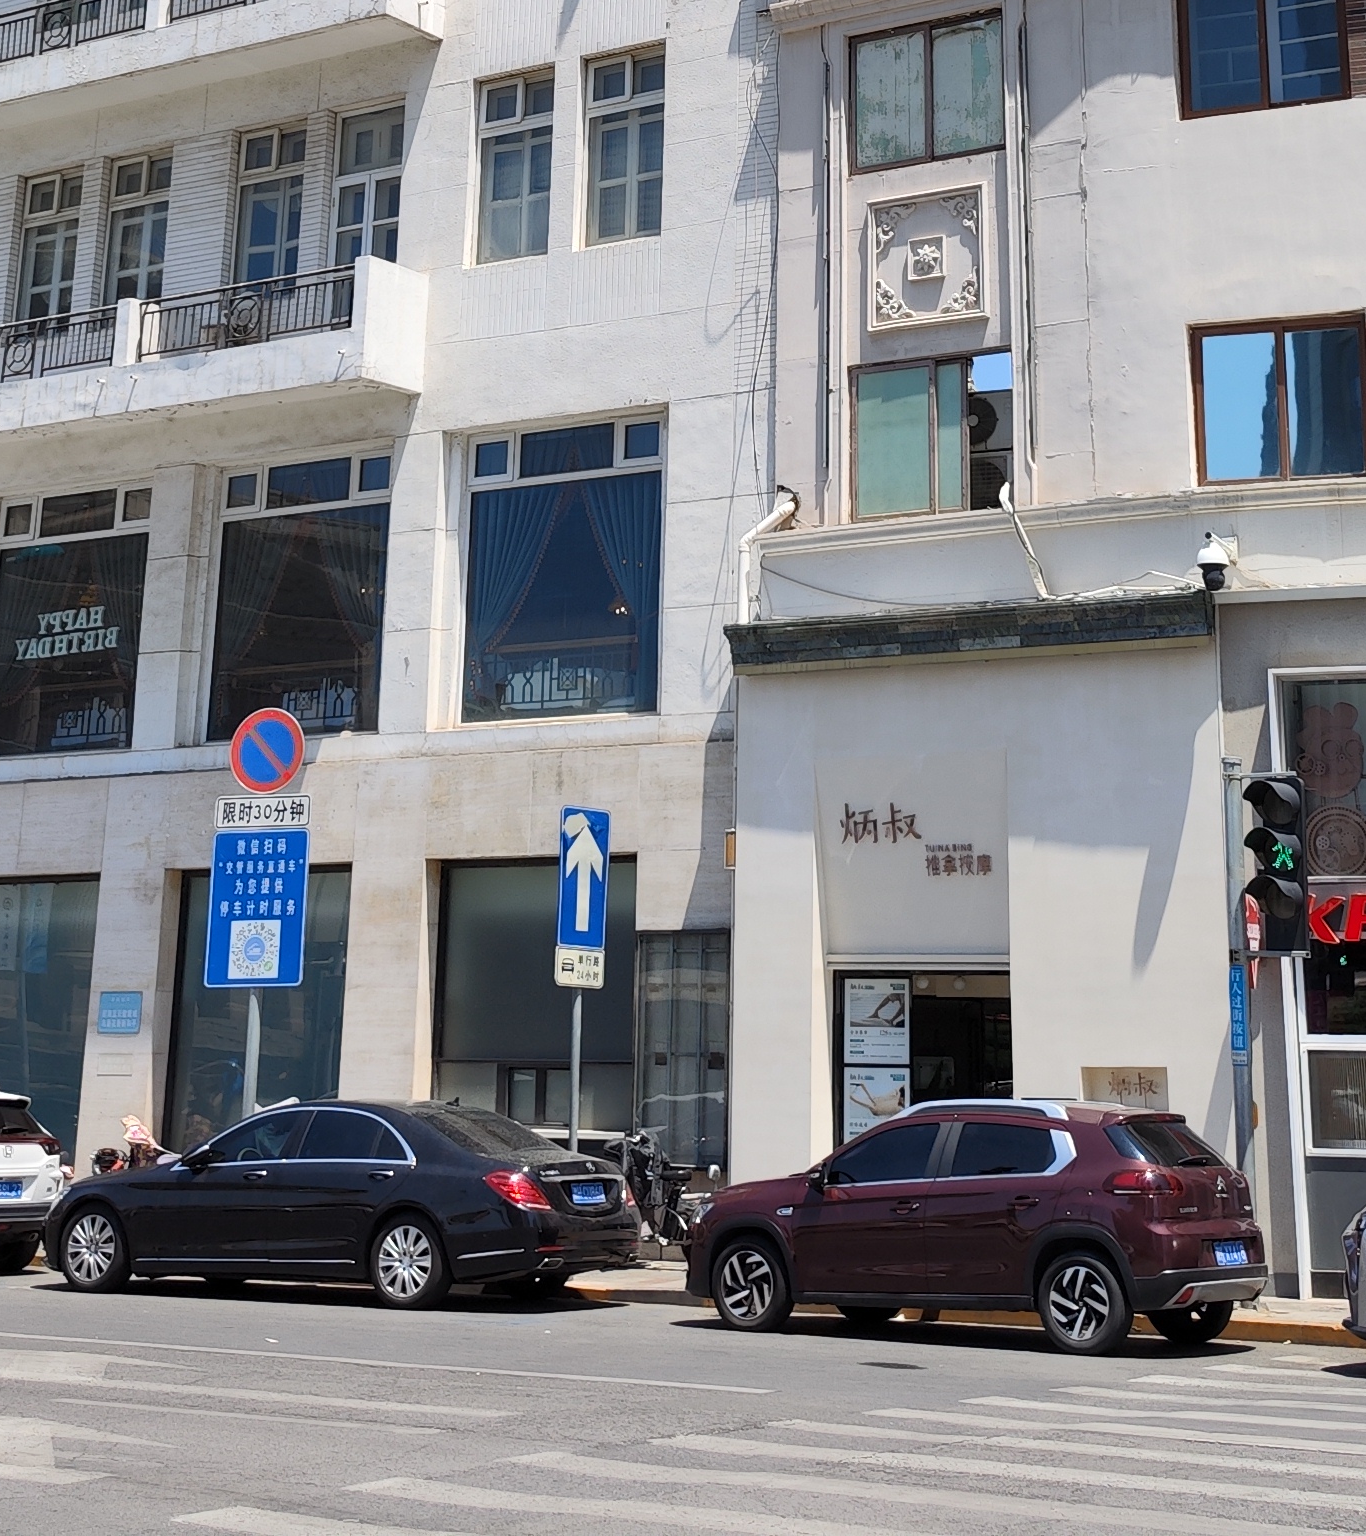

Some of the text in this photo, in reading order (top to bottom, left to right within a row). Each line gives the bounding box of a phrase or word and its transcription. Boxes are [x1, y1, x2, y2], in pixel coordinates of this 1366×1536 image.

[222, 799, 305, 824] 限时30分钟
[839, 802, 923, 845] 炳叔
[236, 838, 287, 856] 微信扫码
[925, 854, 993, 876] 推拿按摩
[234, 878, 284, 895] 为您提供
[219, 899, 296, 917] 停车计时服务
[577, 955, 600, 967] 单行路
[576, 970, 600, 982] 24小时
[1230, 969, 1244, 1049] 行人过街按钮
